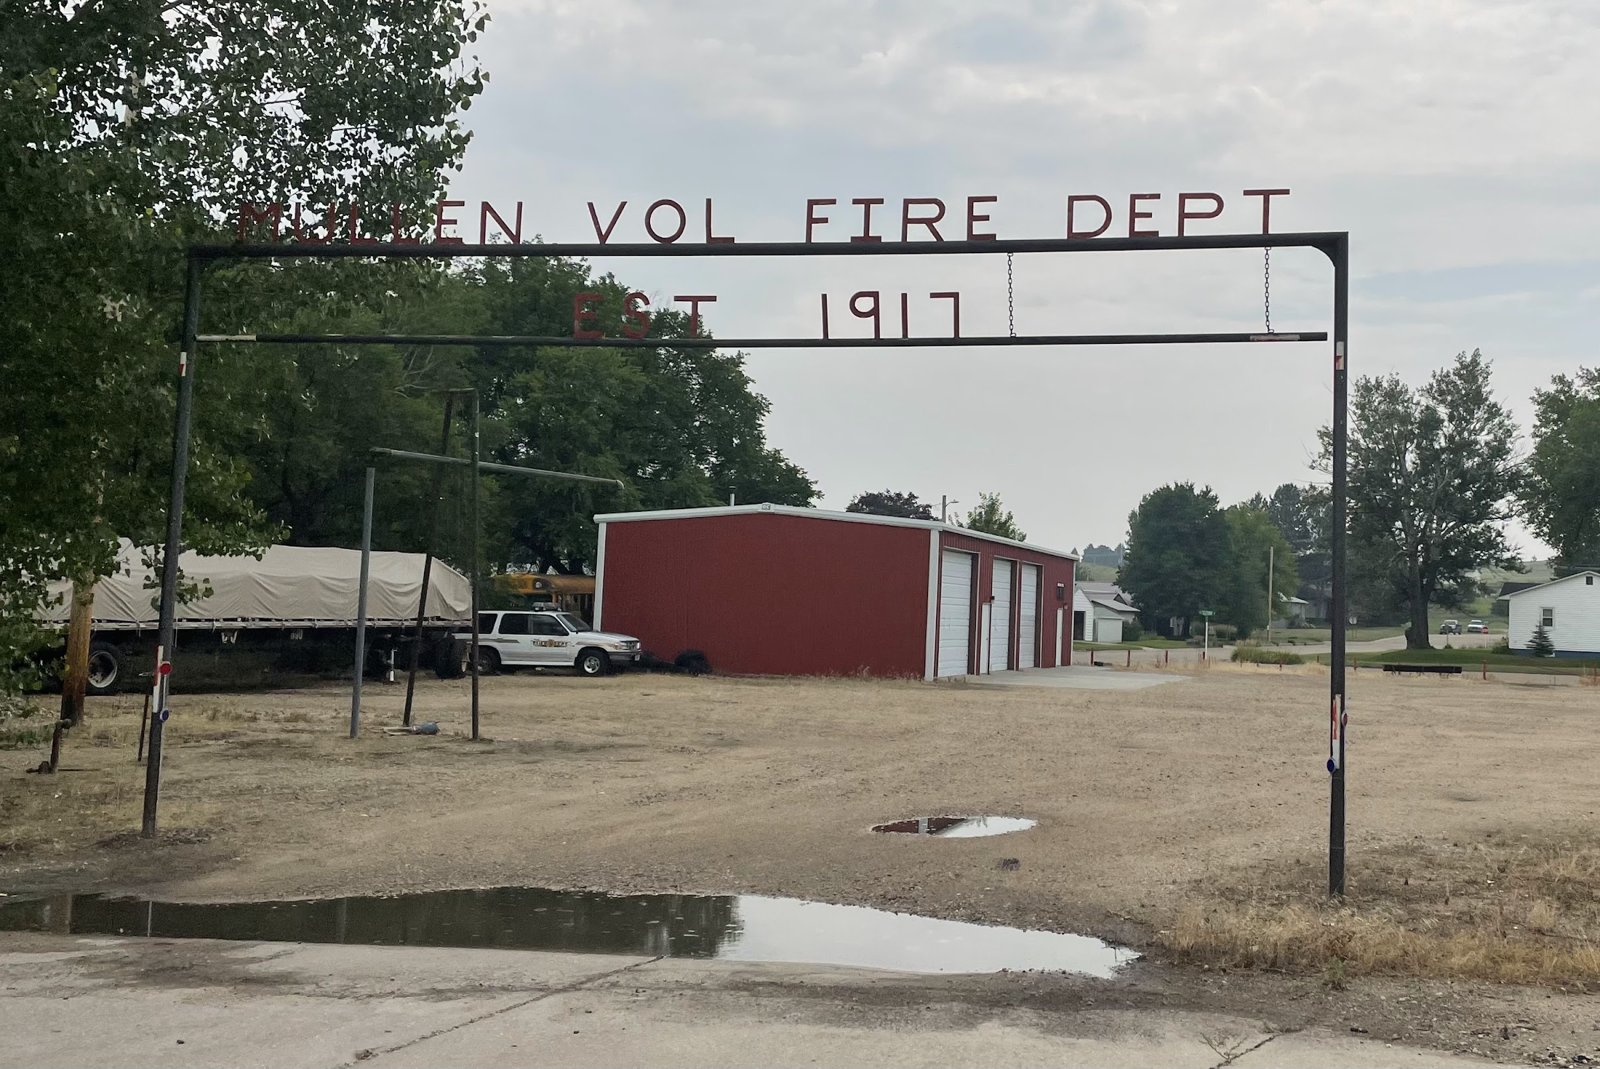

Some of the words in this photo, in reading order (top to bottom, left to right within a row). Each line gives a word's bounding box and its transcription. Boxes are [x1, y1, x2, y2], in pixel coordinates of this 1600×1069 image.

[238, 201, 523, 245] MULLEN
[587, 198, 735, 244] VOL
[805, 195, 998, 243] FIRE
[1066, 188, 1291, 240] DEPT
[574, 292, 717, 339] EST
[821, 290, 960, 340] 1917
